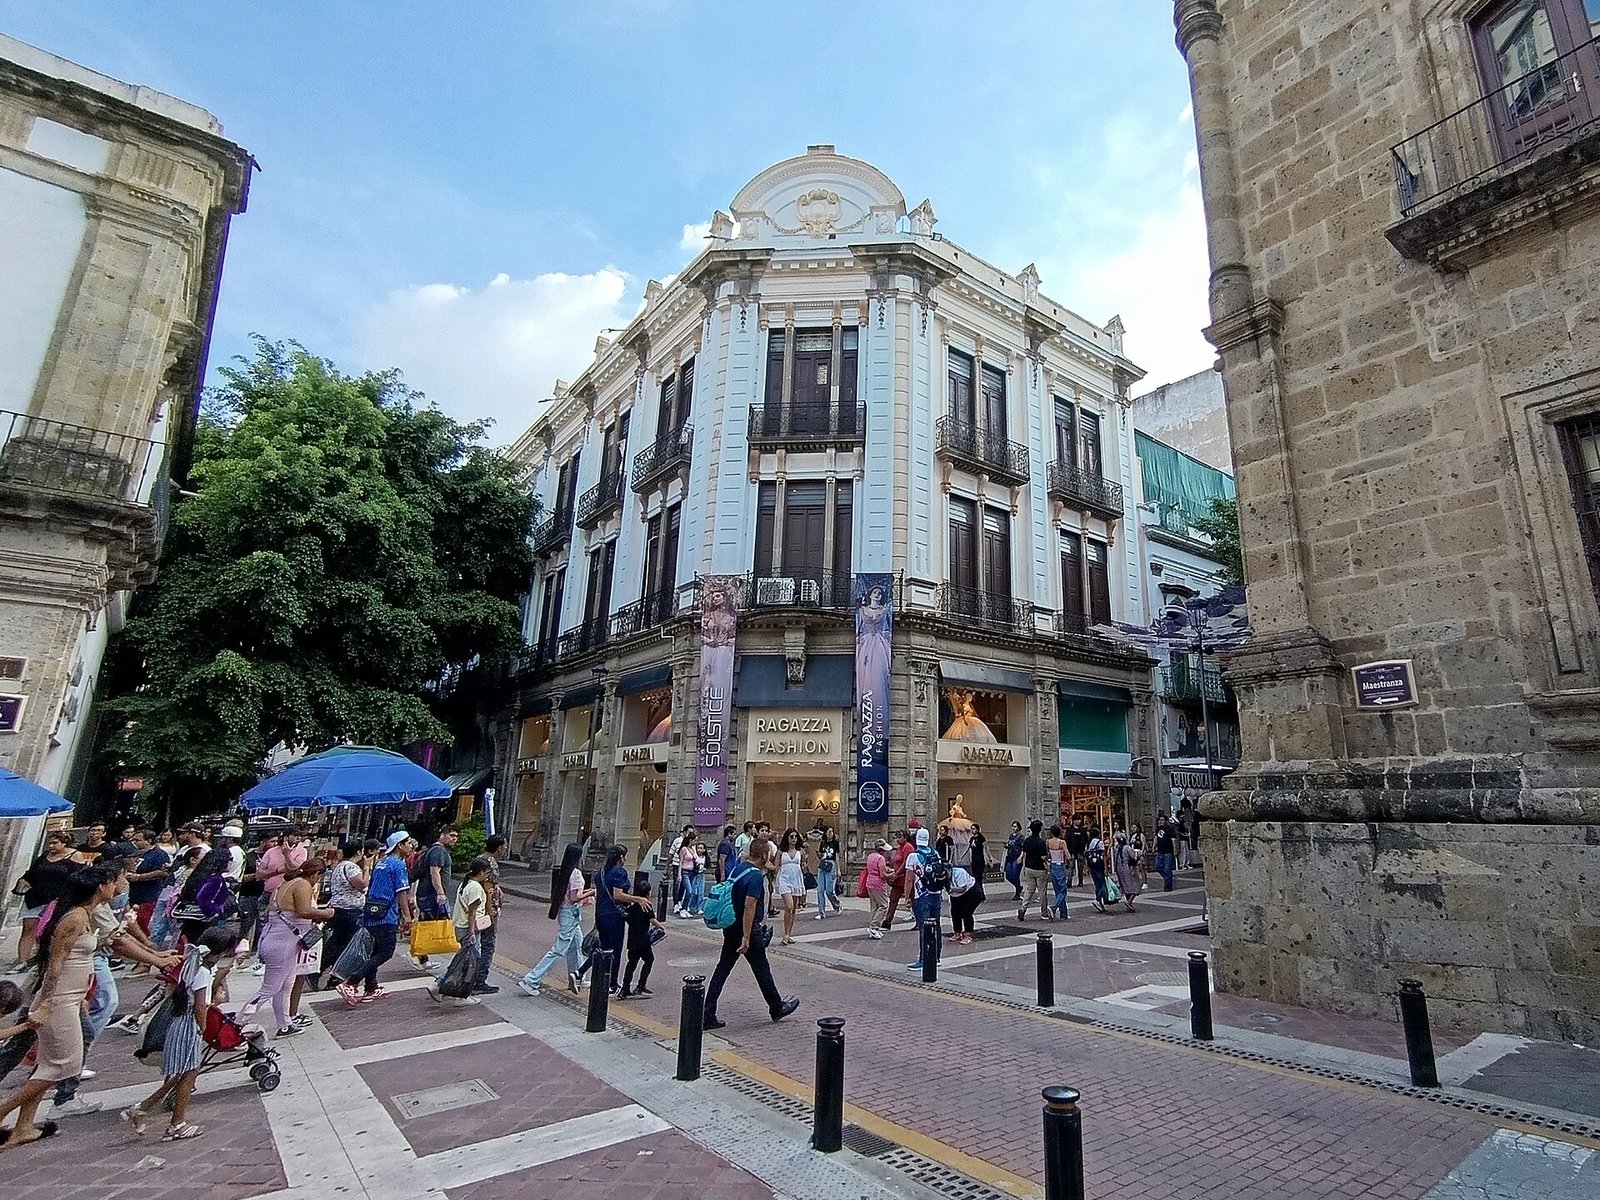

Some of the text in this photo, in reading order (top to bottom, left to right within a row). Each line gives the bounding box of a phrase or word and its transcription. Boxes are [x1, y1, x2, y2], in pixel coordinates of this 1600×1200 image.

[1362, 679, 1404, 690] Maestranza
[705, 687, 724, 767] SOLSTICE
[756, 718, 832, 733] RAGAZZA
[876, 704, 884, 753] FASHION
[757, 739, 830, 754] FASHION
[961, 746, 1014, 763] RAGAZZA
